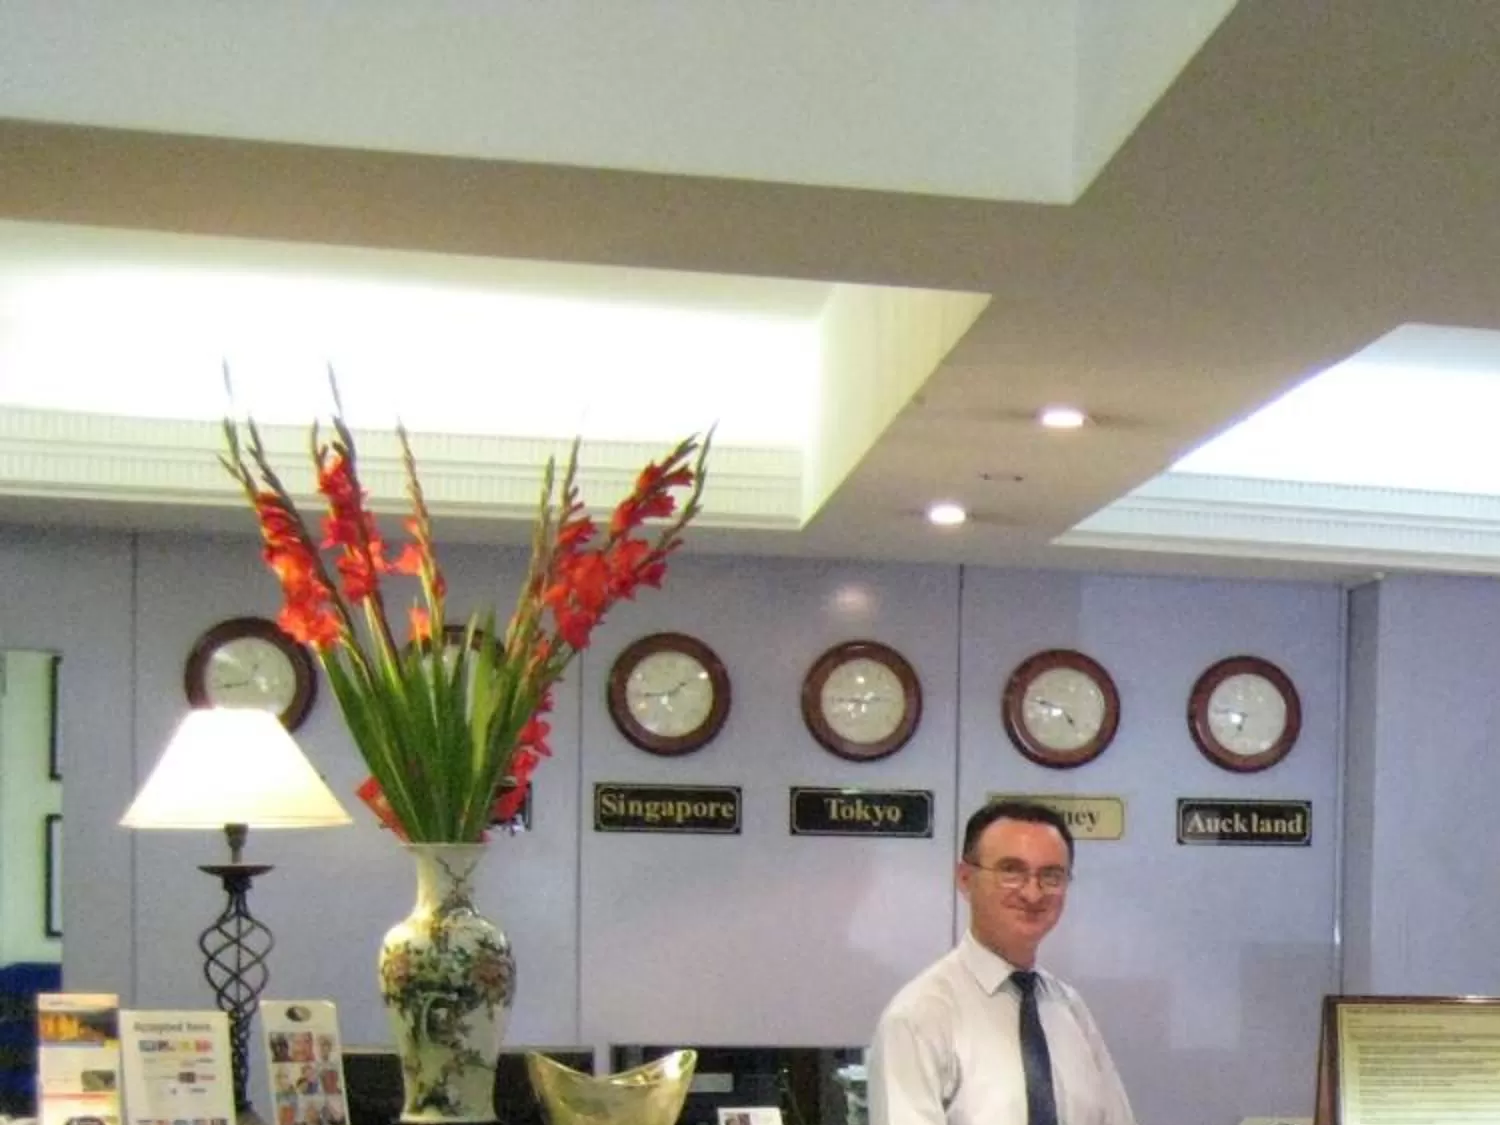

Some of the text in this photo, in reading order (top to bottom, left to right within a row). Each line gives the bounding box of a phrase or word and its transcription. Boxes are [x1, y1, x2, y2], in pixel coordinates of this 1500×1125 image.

[601, 793, 735, 823] Singapore
[823, 797, 902, 827] Tokyo
[1187, 812, 1304, 833] Auckland
